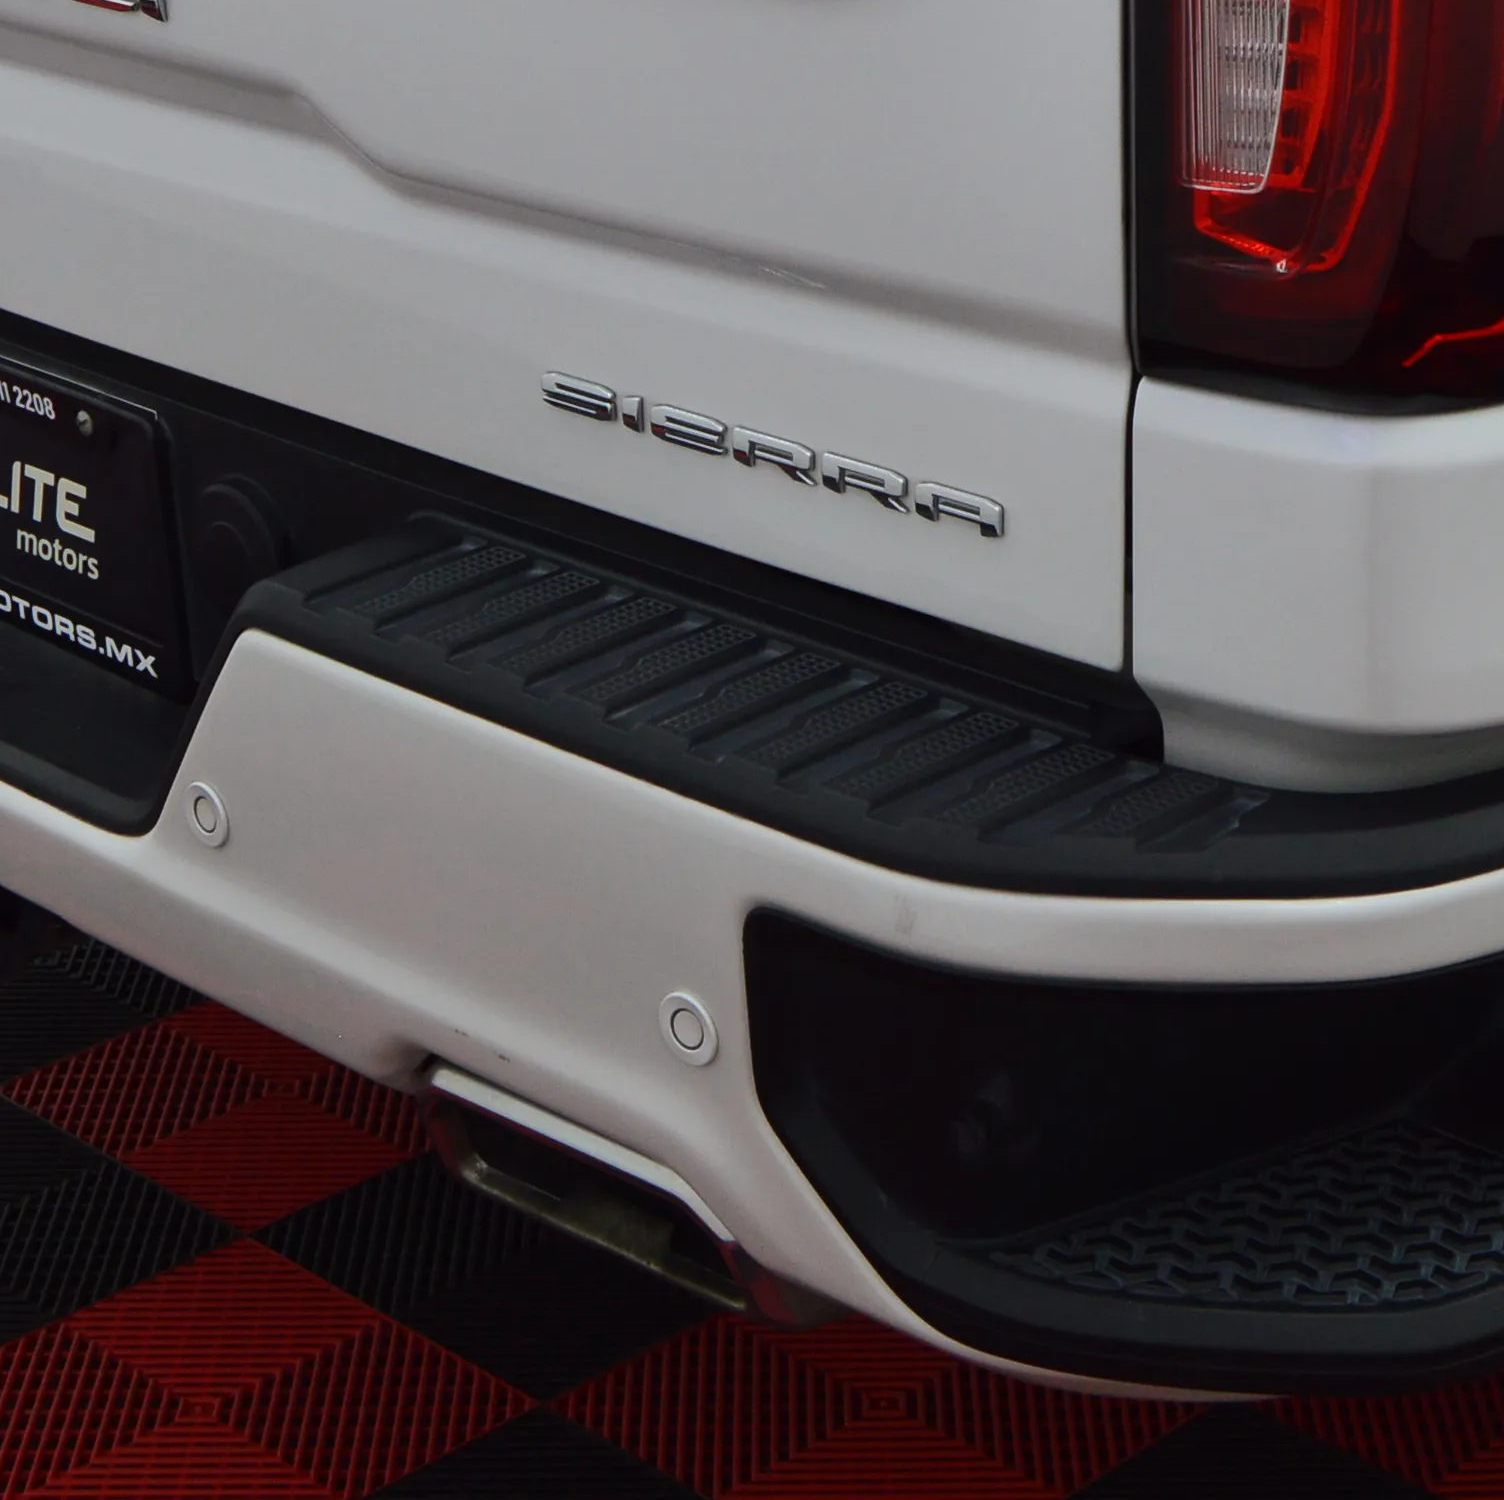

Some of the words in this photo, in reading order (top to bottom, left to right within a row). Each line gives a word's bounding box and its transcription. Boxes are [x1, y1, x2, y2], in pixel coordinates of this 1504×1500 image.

[12, 385, 56, 420] 2208
[541, 370, 1005, 539] SIERRA
[16, 528, 99, 581] motors
